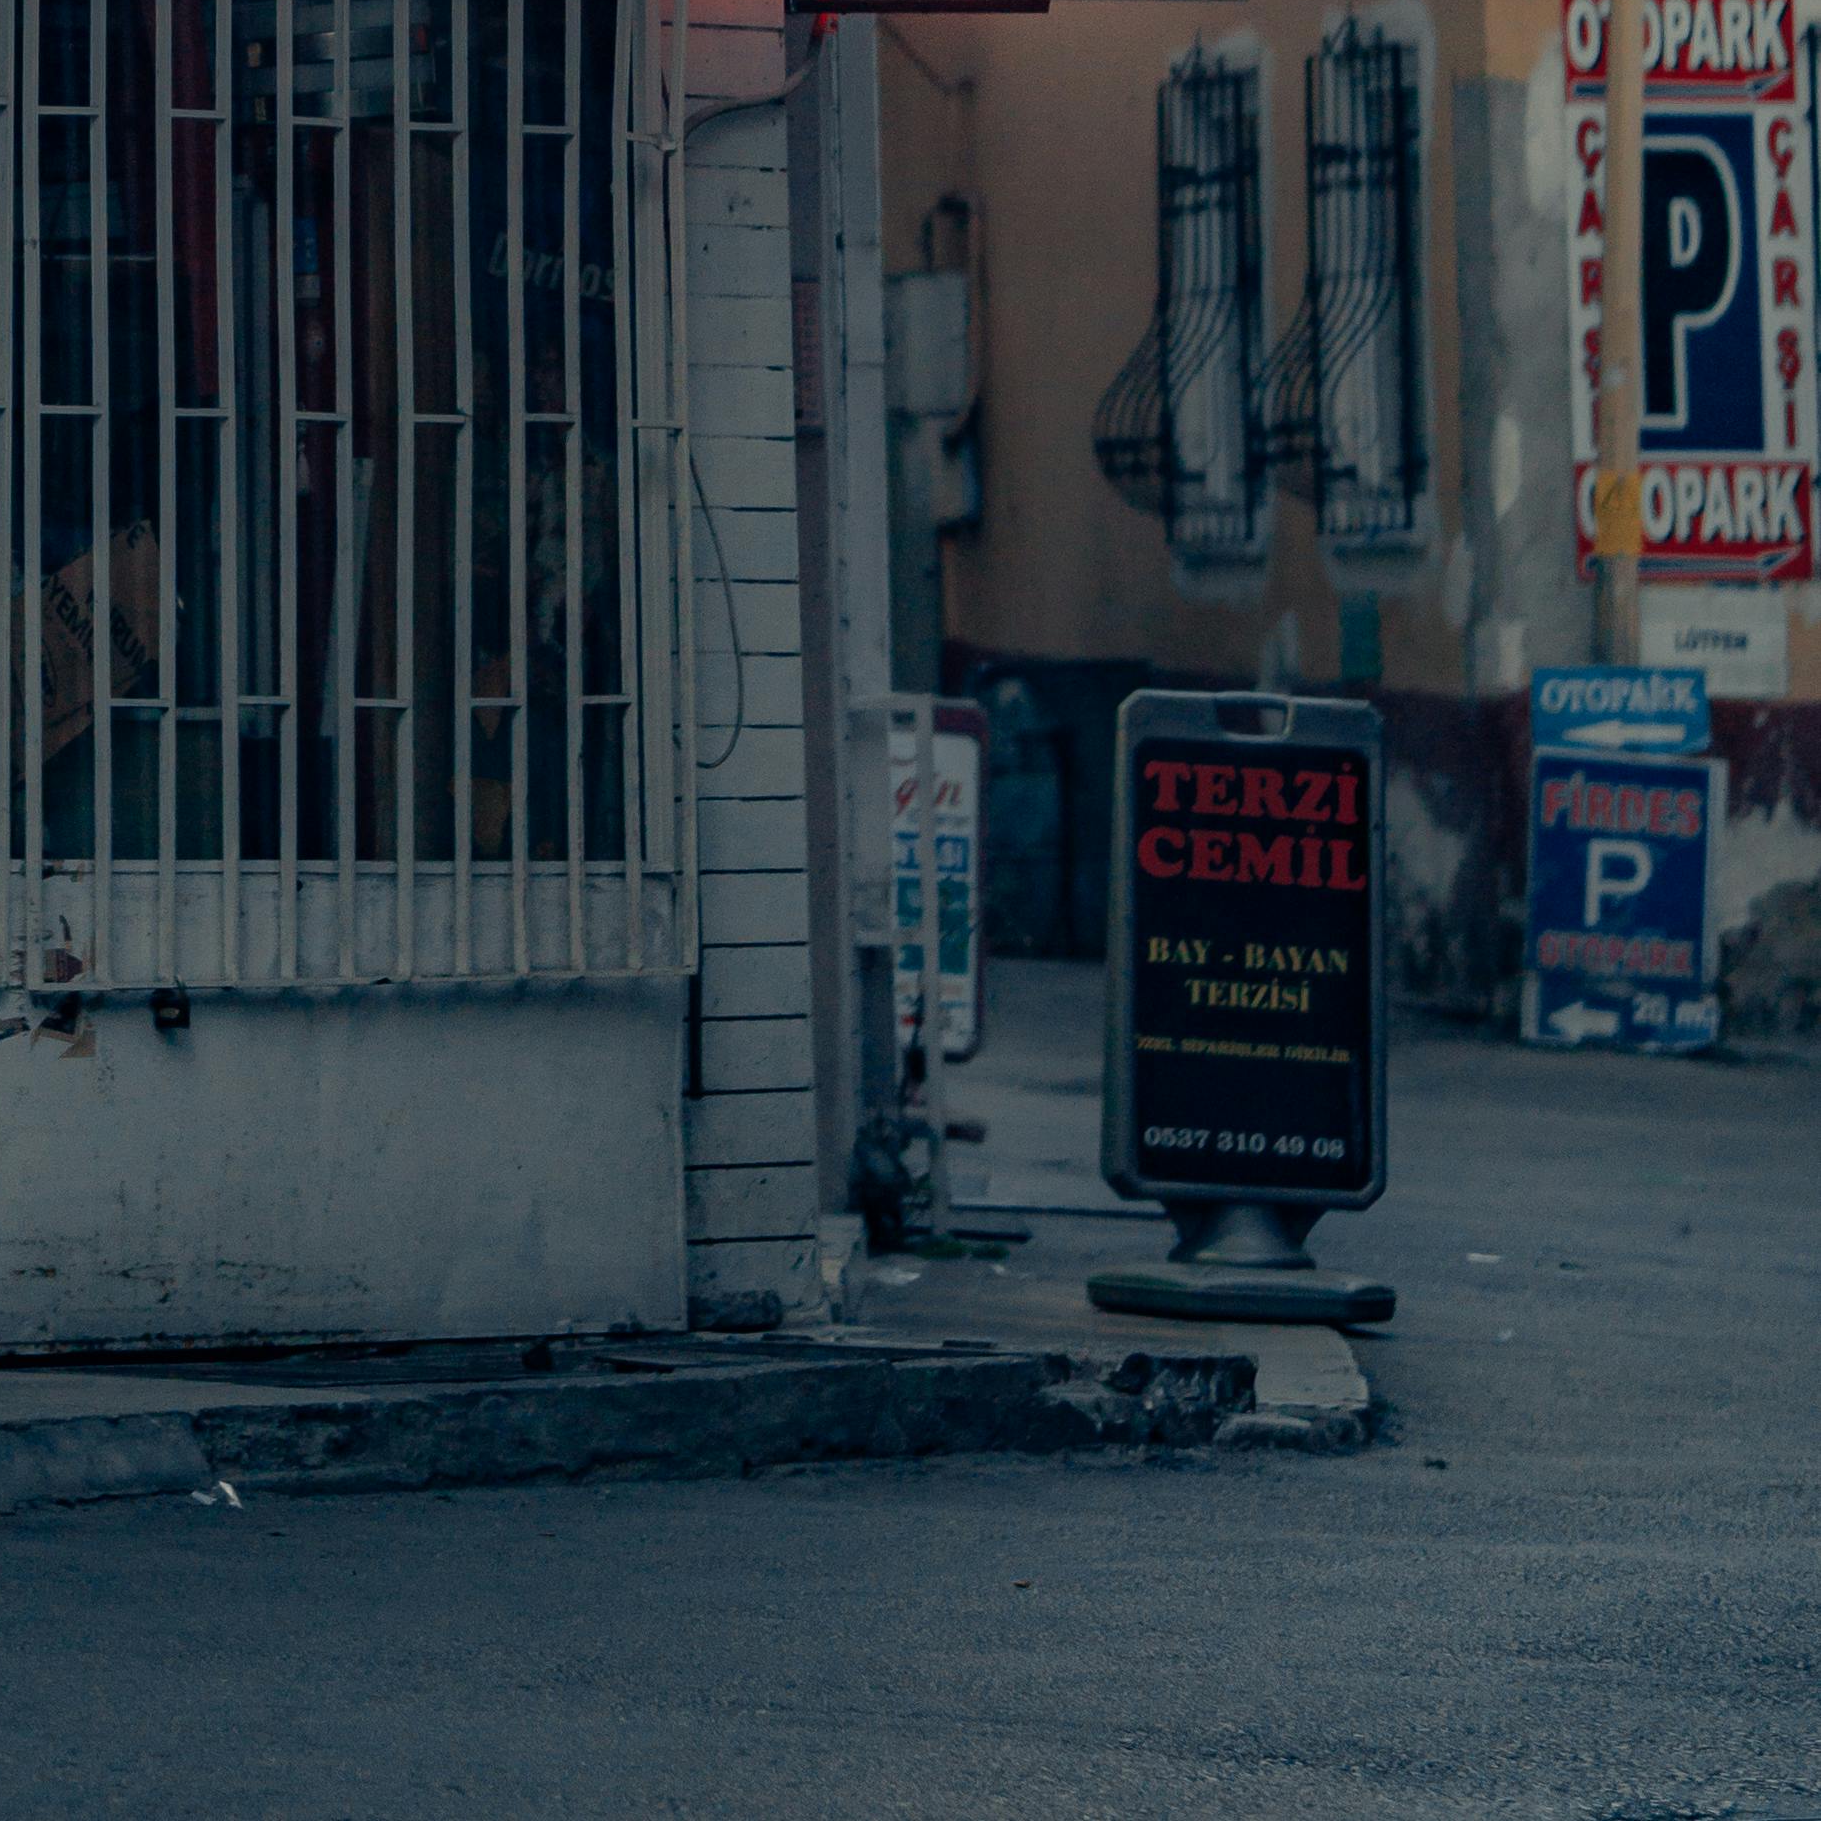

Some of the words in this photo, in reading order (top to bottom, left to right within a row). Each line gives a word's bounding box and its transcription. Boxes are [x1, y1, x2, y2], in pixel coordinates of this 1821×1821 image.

[1539, 673, 1700, 716] OTOPARK
[1143, 758, 1360, 827] TERZİ
[1540, 770, 1706, 840] FİRDES
[1137, 824, 1368, 893] CEMİL
[1583, 837, 1654, 929] P
[1146, 935, 1212, 967] BAY
[1243, 941, 1350, 976] BAYAN
[1535, 928, 1695, 979] OTOPARK
[1184, 977, 1311, 1015] TERZİSİ
[1142, 1125, 1212, 1150] 0537
[1216, 1129, 1267, 1154] 310
[1273, 1133, 1306, 1156] 49
[1311, 1136, 1346, 1160] 08
